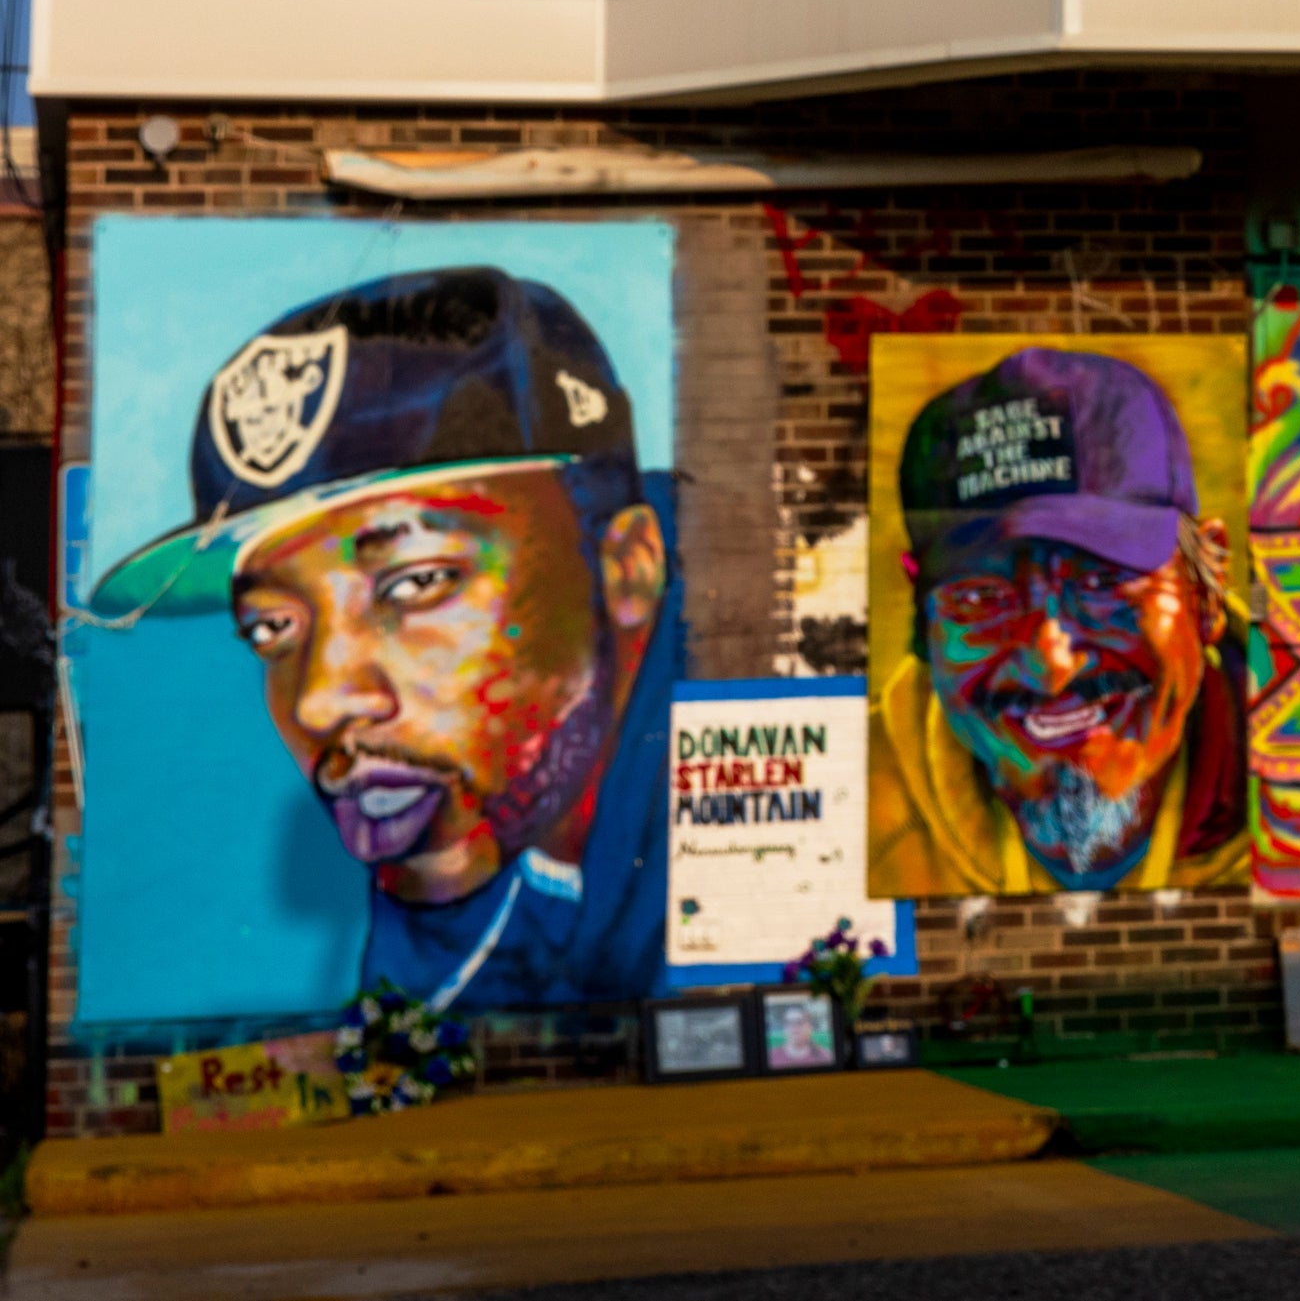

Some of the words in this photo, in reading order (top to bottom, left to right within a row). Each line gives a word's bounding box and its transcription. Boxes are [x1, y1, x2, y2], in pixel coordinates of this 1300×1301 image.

[956, 415, 1062, 460] AGAINST
[983, 440, 1029, 468] THE
[957, 456, 1072, 502] MACHINE
[679, 723, 827, 760] DONAVAN
[676, 789, 822, 825] MOUNTAIN
[202, 1056, 286, 1097] Rest
